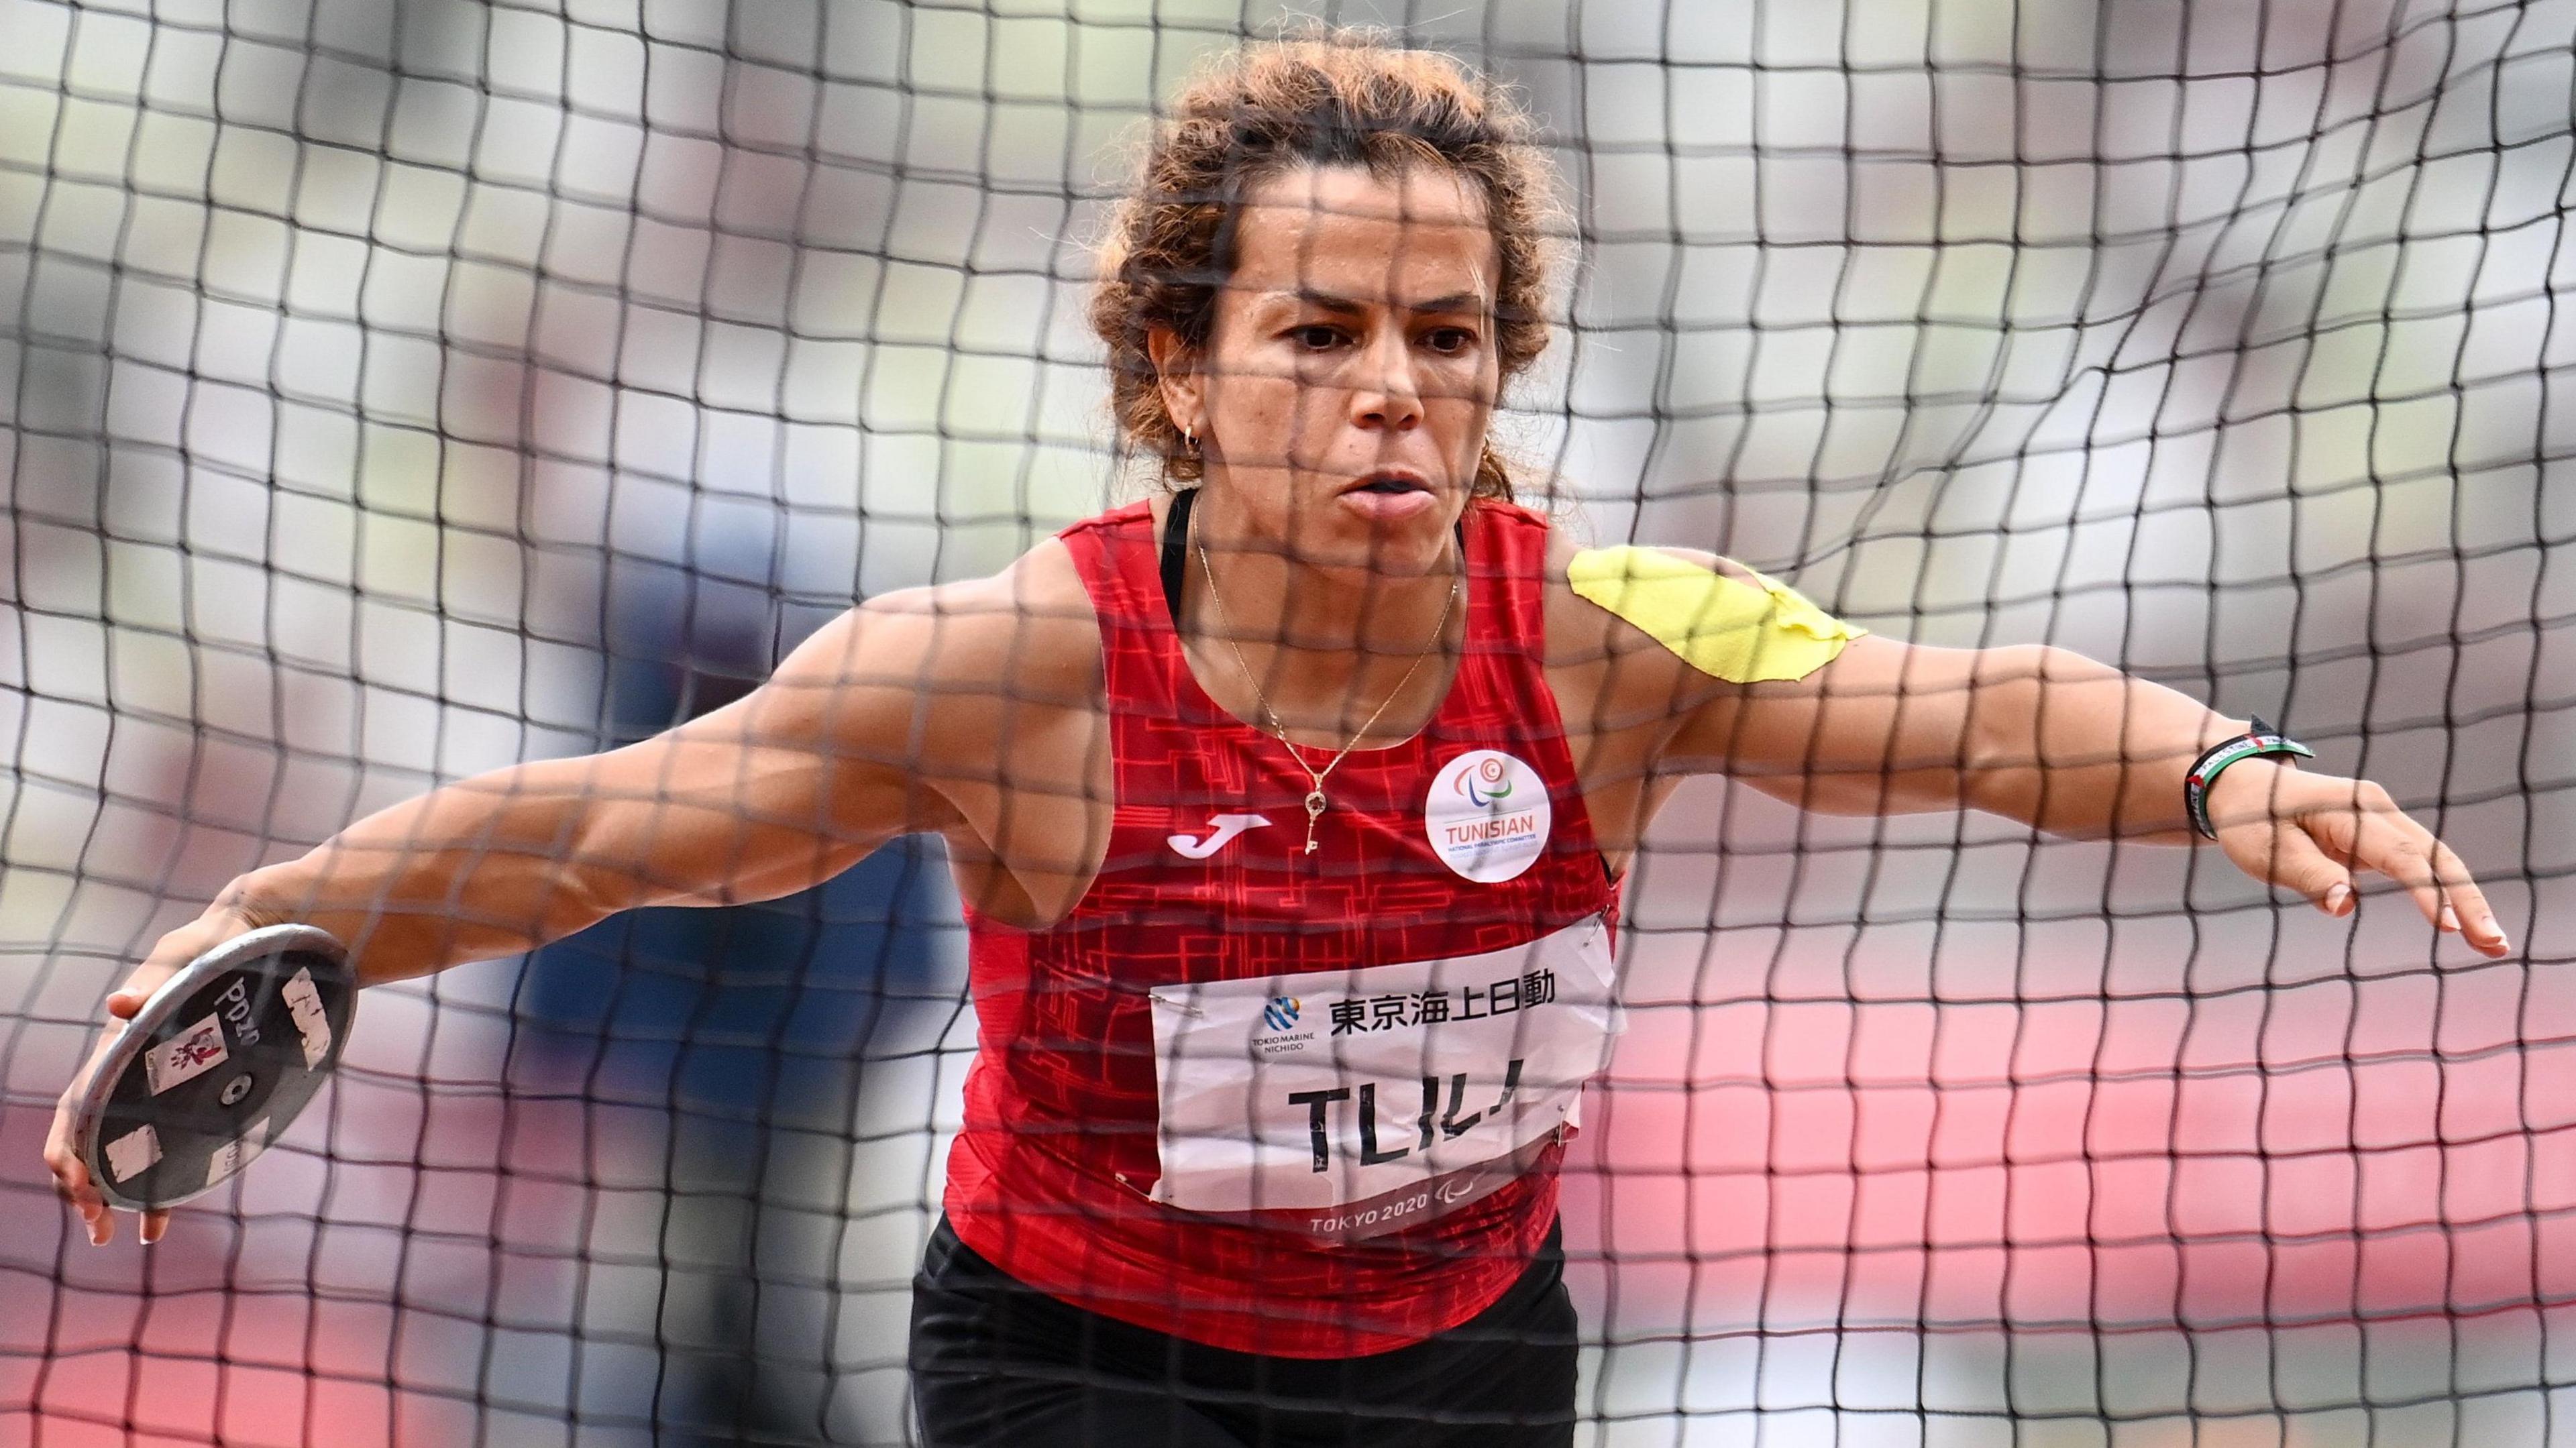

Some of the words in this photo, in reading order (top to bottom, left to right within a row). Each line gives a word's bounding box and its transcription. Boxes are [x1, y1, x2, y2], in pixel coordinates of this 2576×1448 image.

[1446, 815, 1533, 844] TUNISIAN
[1507, 834, 1536, 843] COMMITTEE
[1329, 968, 1555, 1036] 東京海上日動
[1252, 1036, 1279, 1046] TOKIO
[1280, 1032, 1315, 1043] MARINE
[1265, 1043, 1303, 1053] NICHIDO
[1310, 1210, 1377, 1232] TOKYO
[1381, 1193, 1428, 1221] 2020
